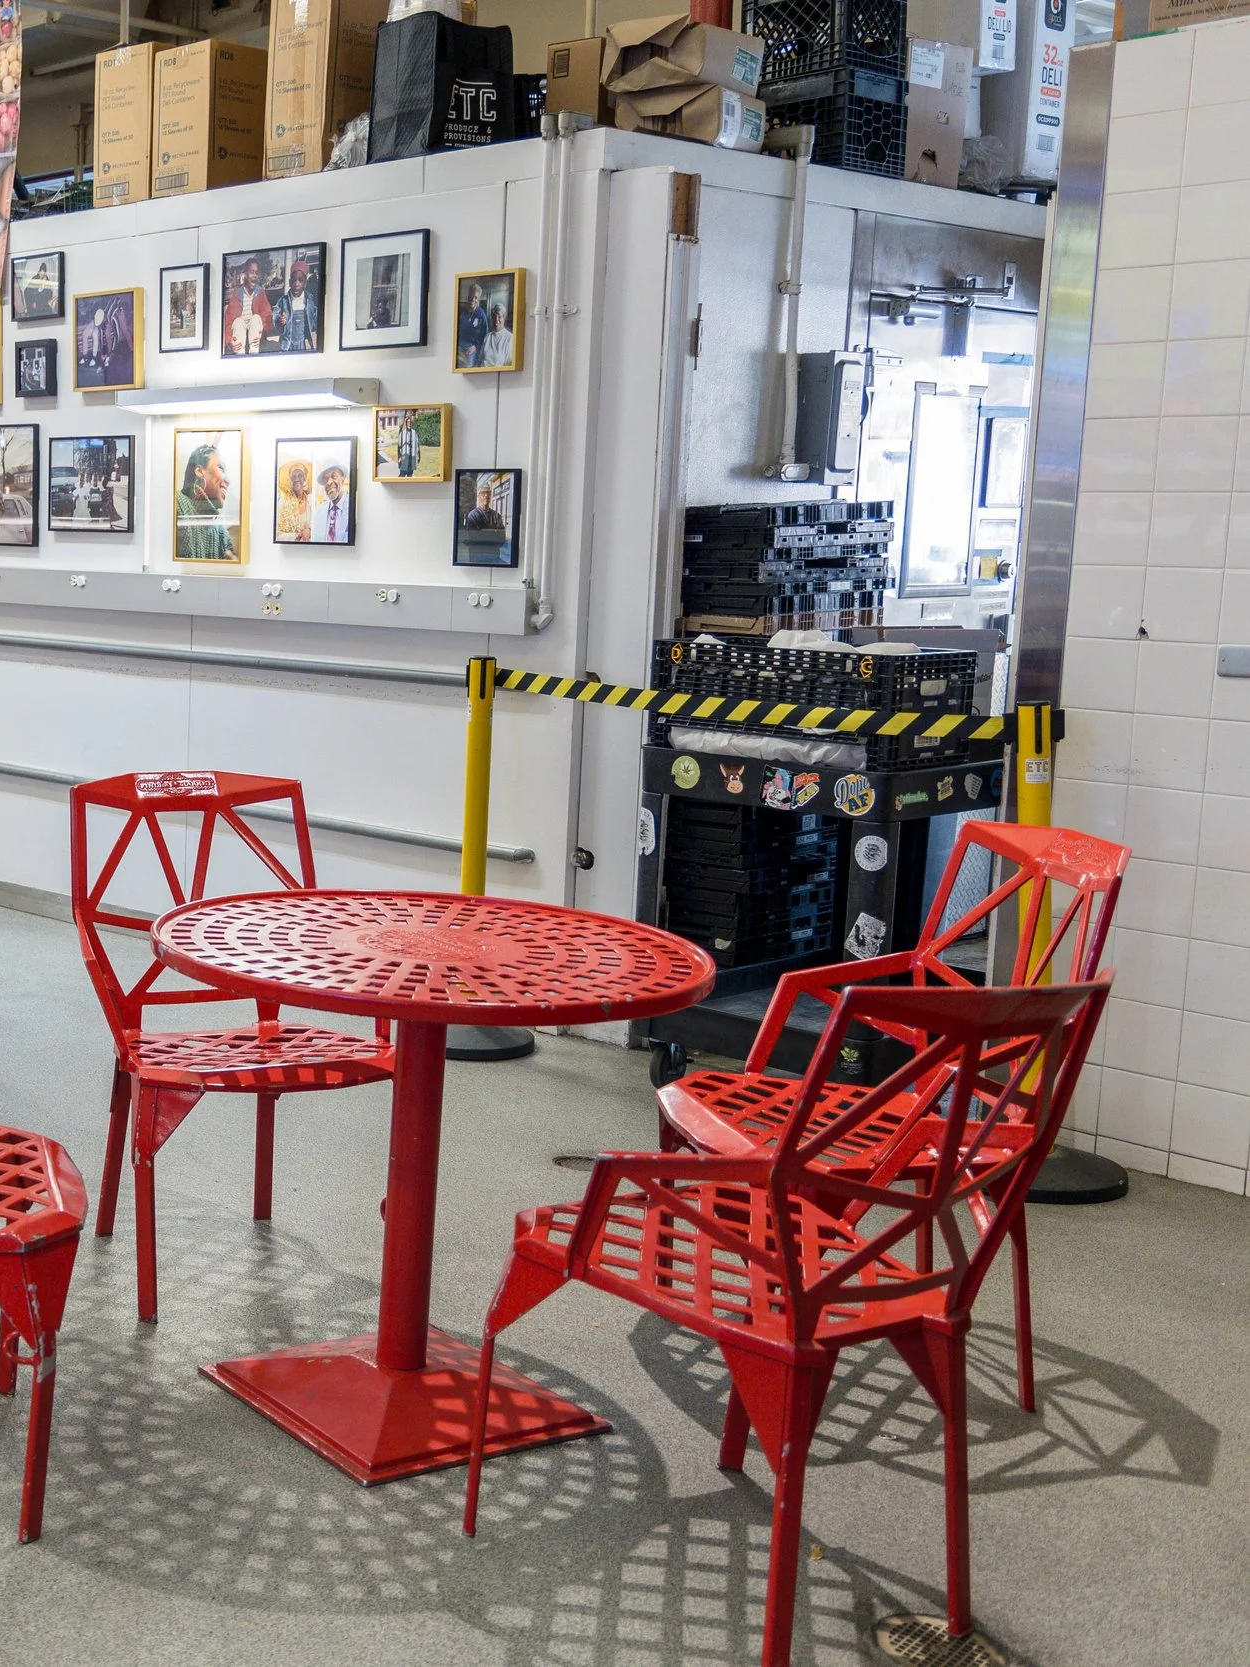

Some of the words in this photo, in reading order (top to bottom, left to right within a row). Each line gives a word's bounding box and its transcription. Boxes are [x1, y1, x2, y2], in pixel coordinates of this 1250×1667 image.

[1041, 66, 1063, 87] DELI
[444, 122, 479, 134] PRODUCE
[486, 126, 492, 134] &
[443, 132, 492, 143] PROVISIONS
[1026, 761, 1048, 773] ETC
[847, 792, 869, 812] AF
